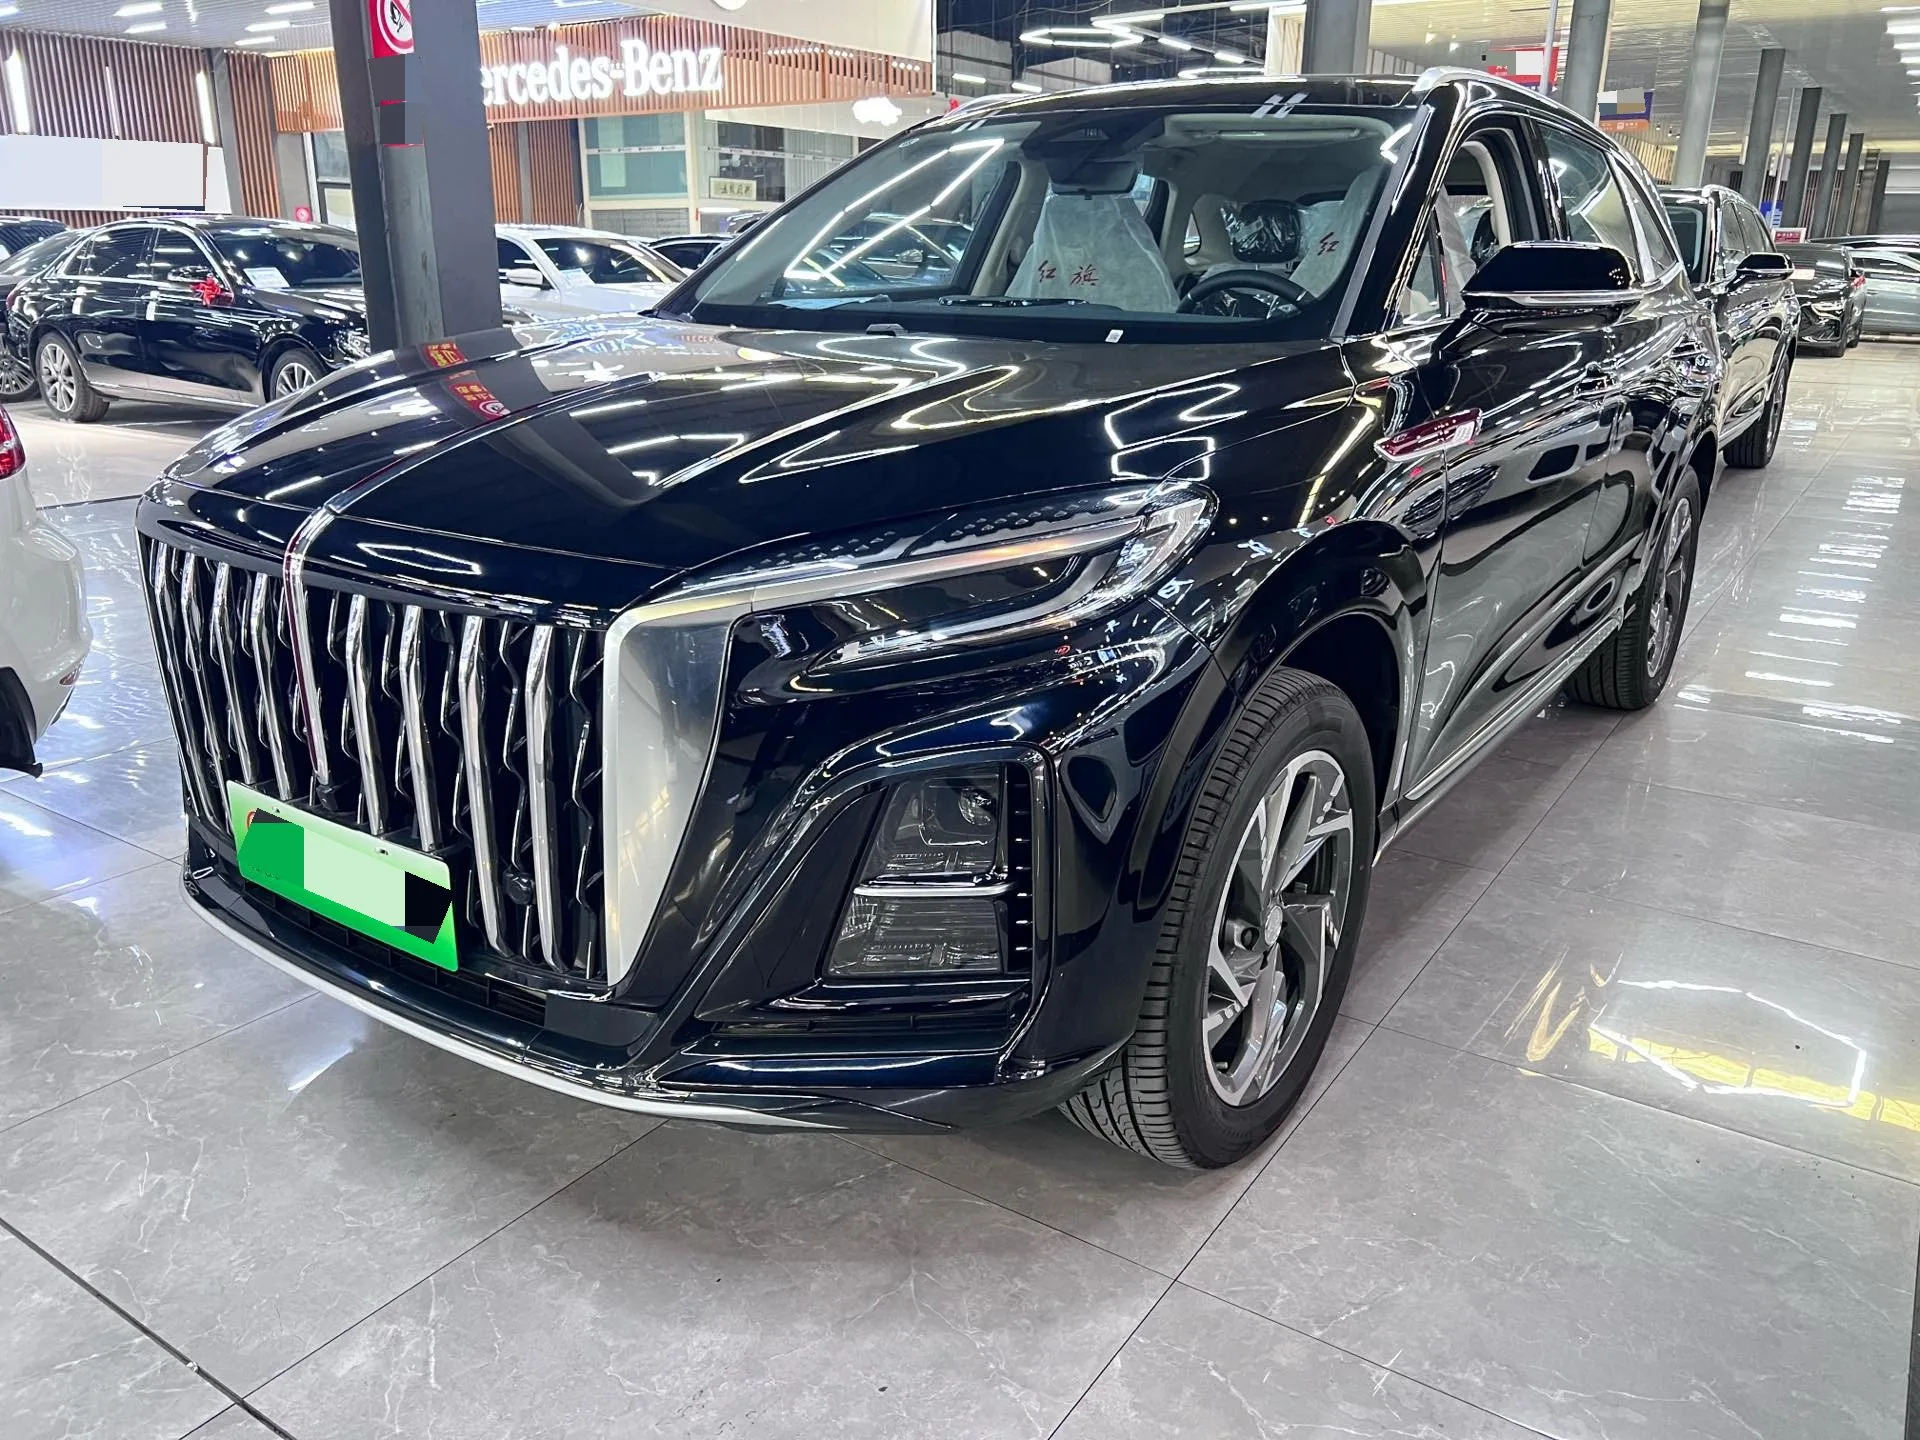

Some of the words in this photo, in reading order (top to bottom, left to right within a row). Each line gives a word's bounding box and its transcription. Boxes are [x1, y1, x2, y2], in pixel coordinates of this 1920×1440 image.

[480, 38, 723, 106] ercedes-Benz
[1317, 231, 1340, 256] 红
[1037, 260, 1100, 287] 红旗
